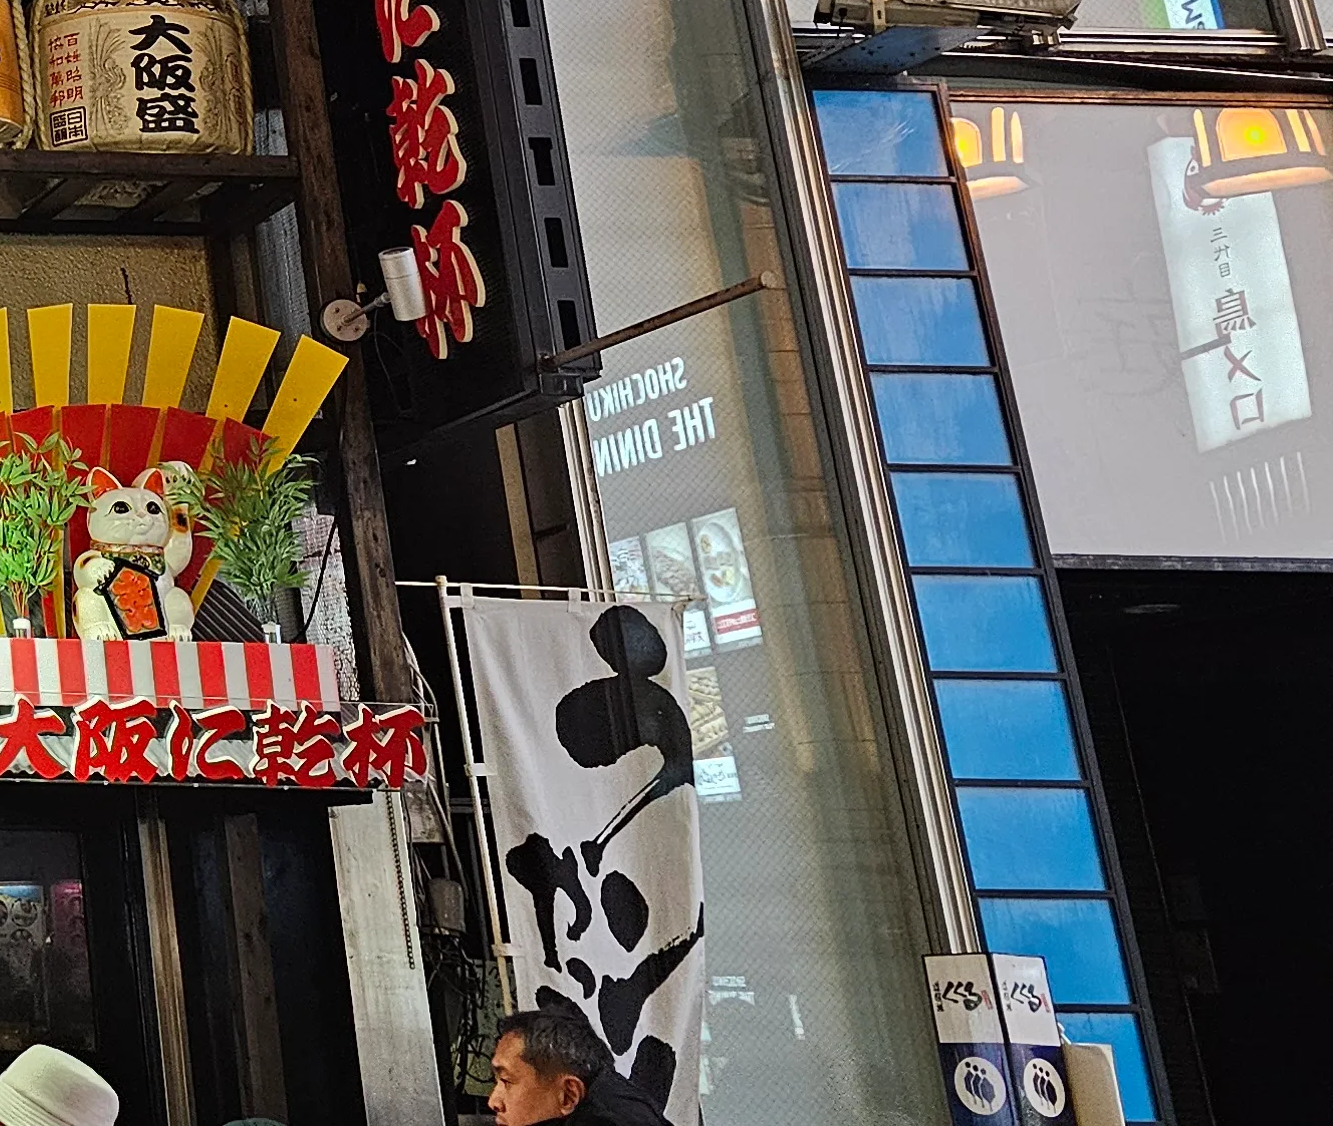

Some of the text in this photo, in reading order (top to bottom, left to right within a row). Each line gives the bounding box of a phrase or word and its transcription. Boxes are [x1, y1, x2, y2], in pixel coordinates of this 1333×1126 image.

[128, 13, 201, 135] 大阪盛
[942, 981, 983, 1011] くくる
[1010, 981, 1042, 1013] くくる
